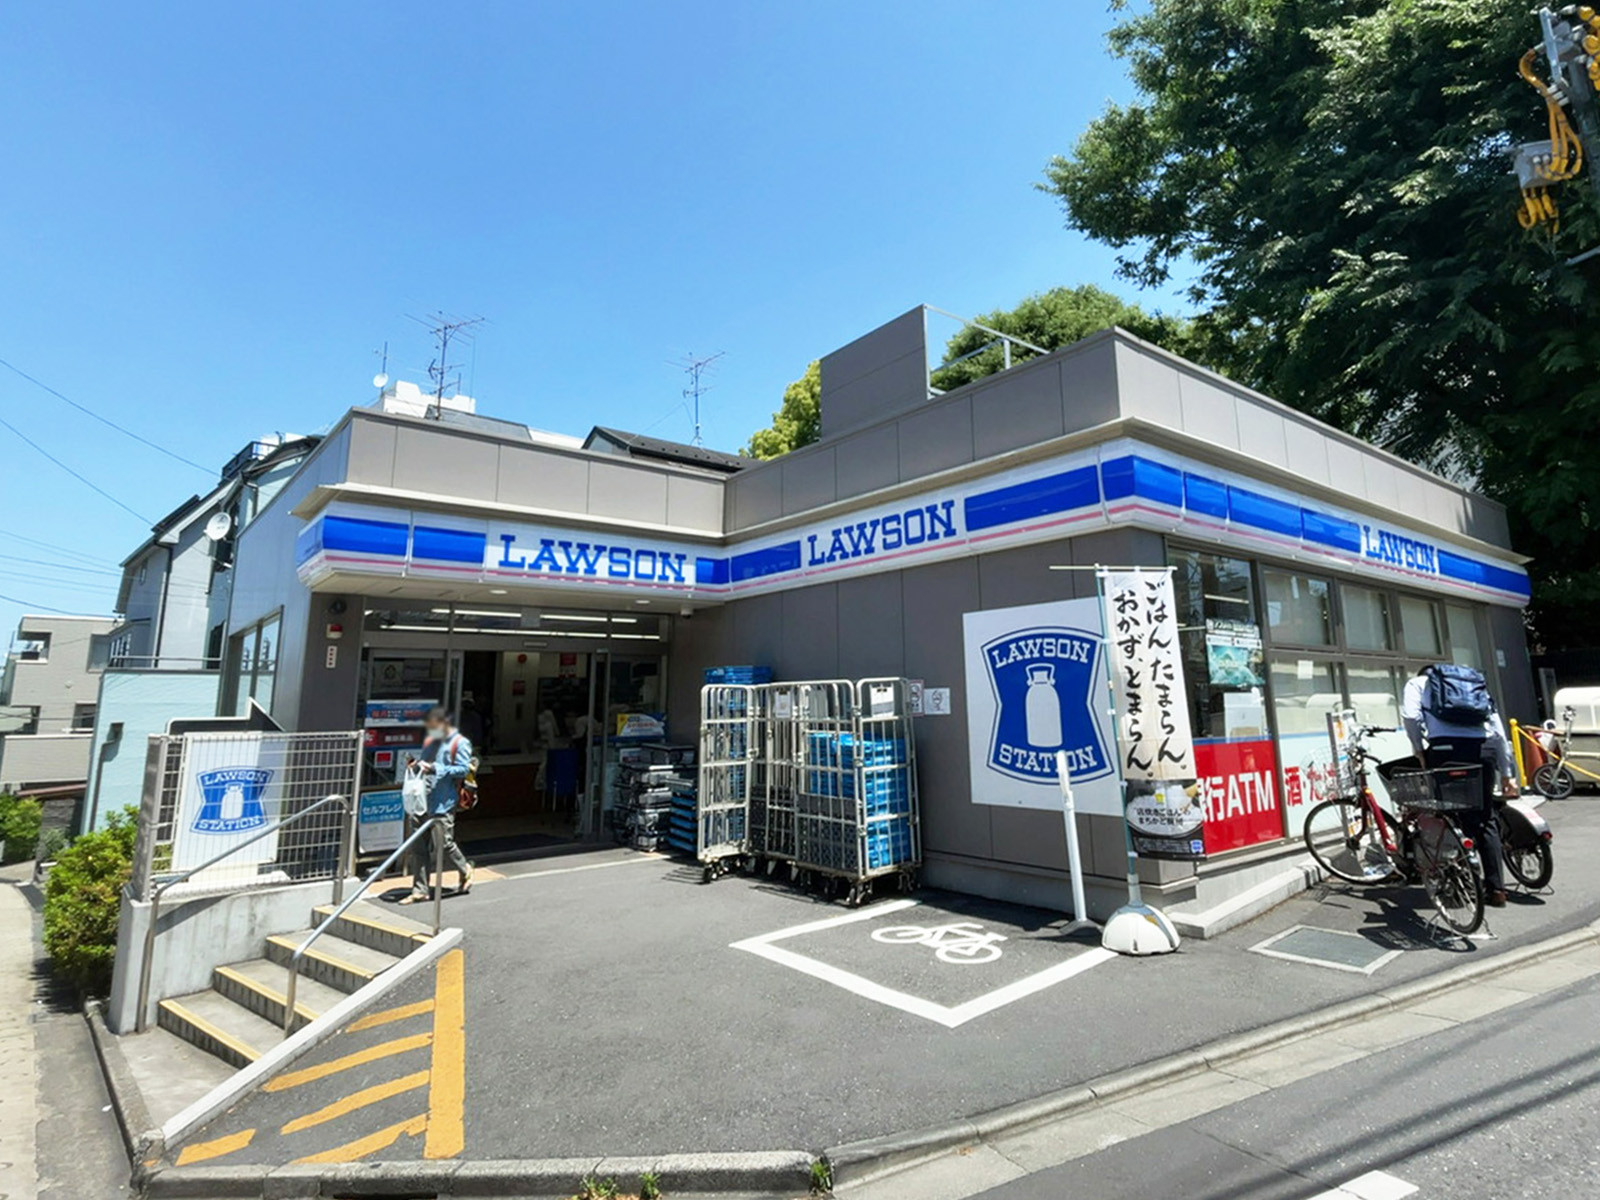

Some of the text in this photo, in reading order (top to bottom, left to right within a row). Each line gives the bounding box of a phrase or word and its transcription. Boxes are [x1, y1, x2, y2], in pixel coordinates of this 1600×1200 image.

[807, 499, 957, 567] LAWSON
[1363, 525, 1436, 573] LAWSON
[499, 534, 686, 583] LAWSON
[992, 638, 1091, 669] LAWSON
[1113, 590, 1154, 778] おかず、とまらん。
[1144, 580, 1186, 770] ごはん、たまらん。
[203, 770, 266, 785] LAWSON
[998, 743, 1097, 773] STATON
[198, 815, 261, 830] STATION
[363, 804, 401, 815] セルフレジ
